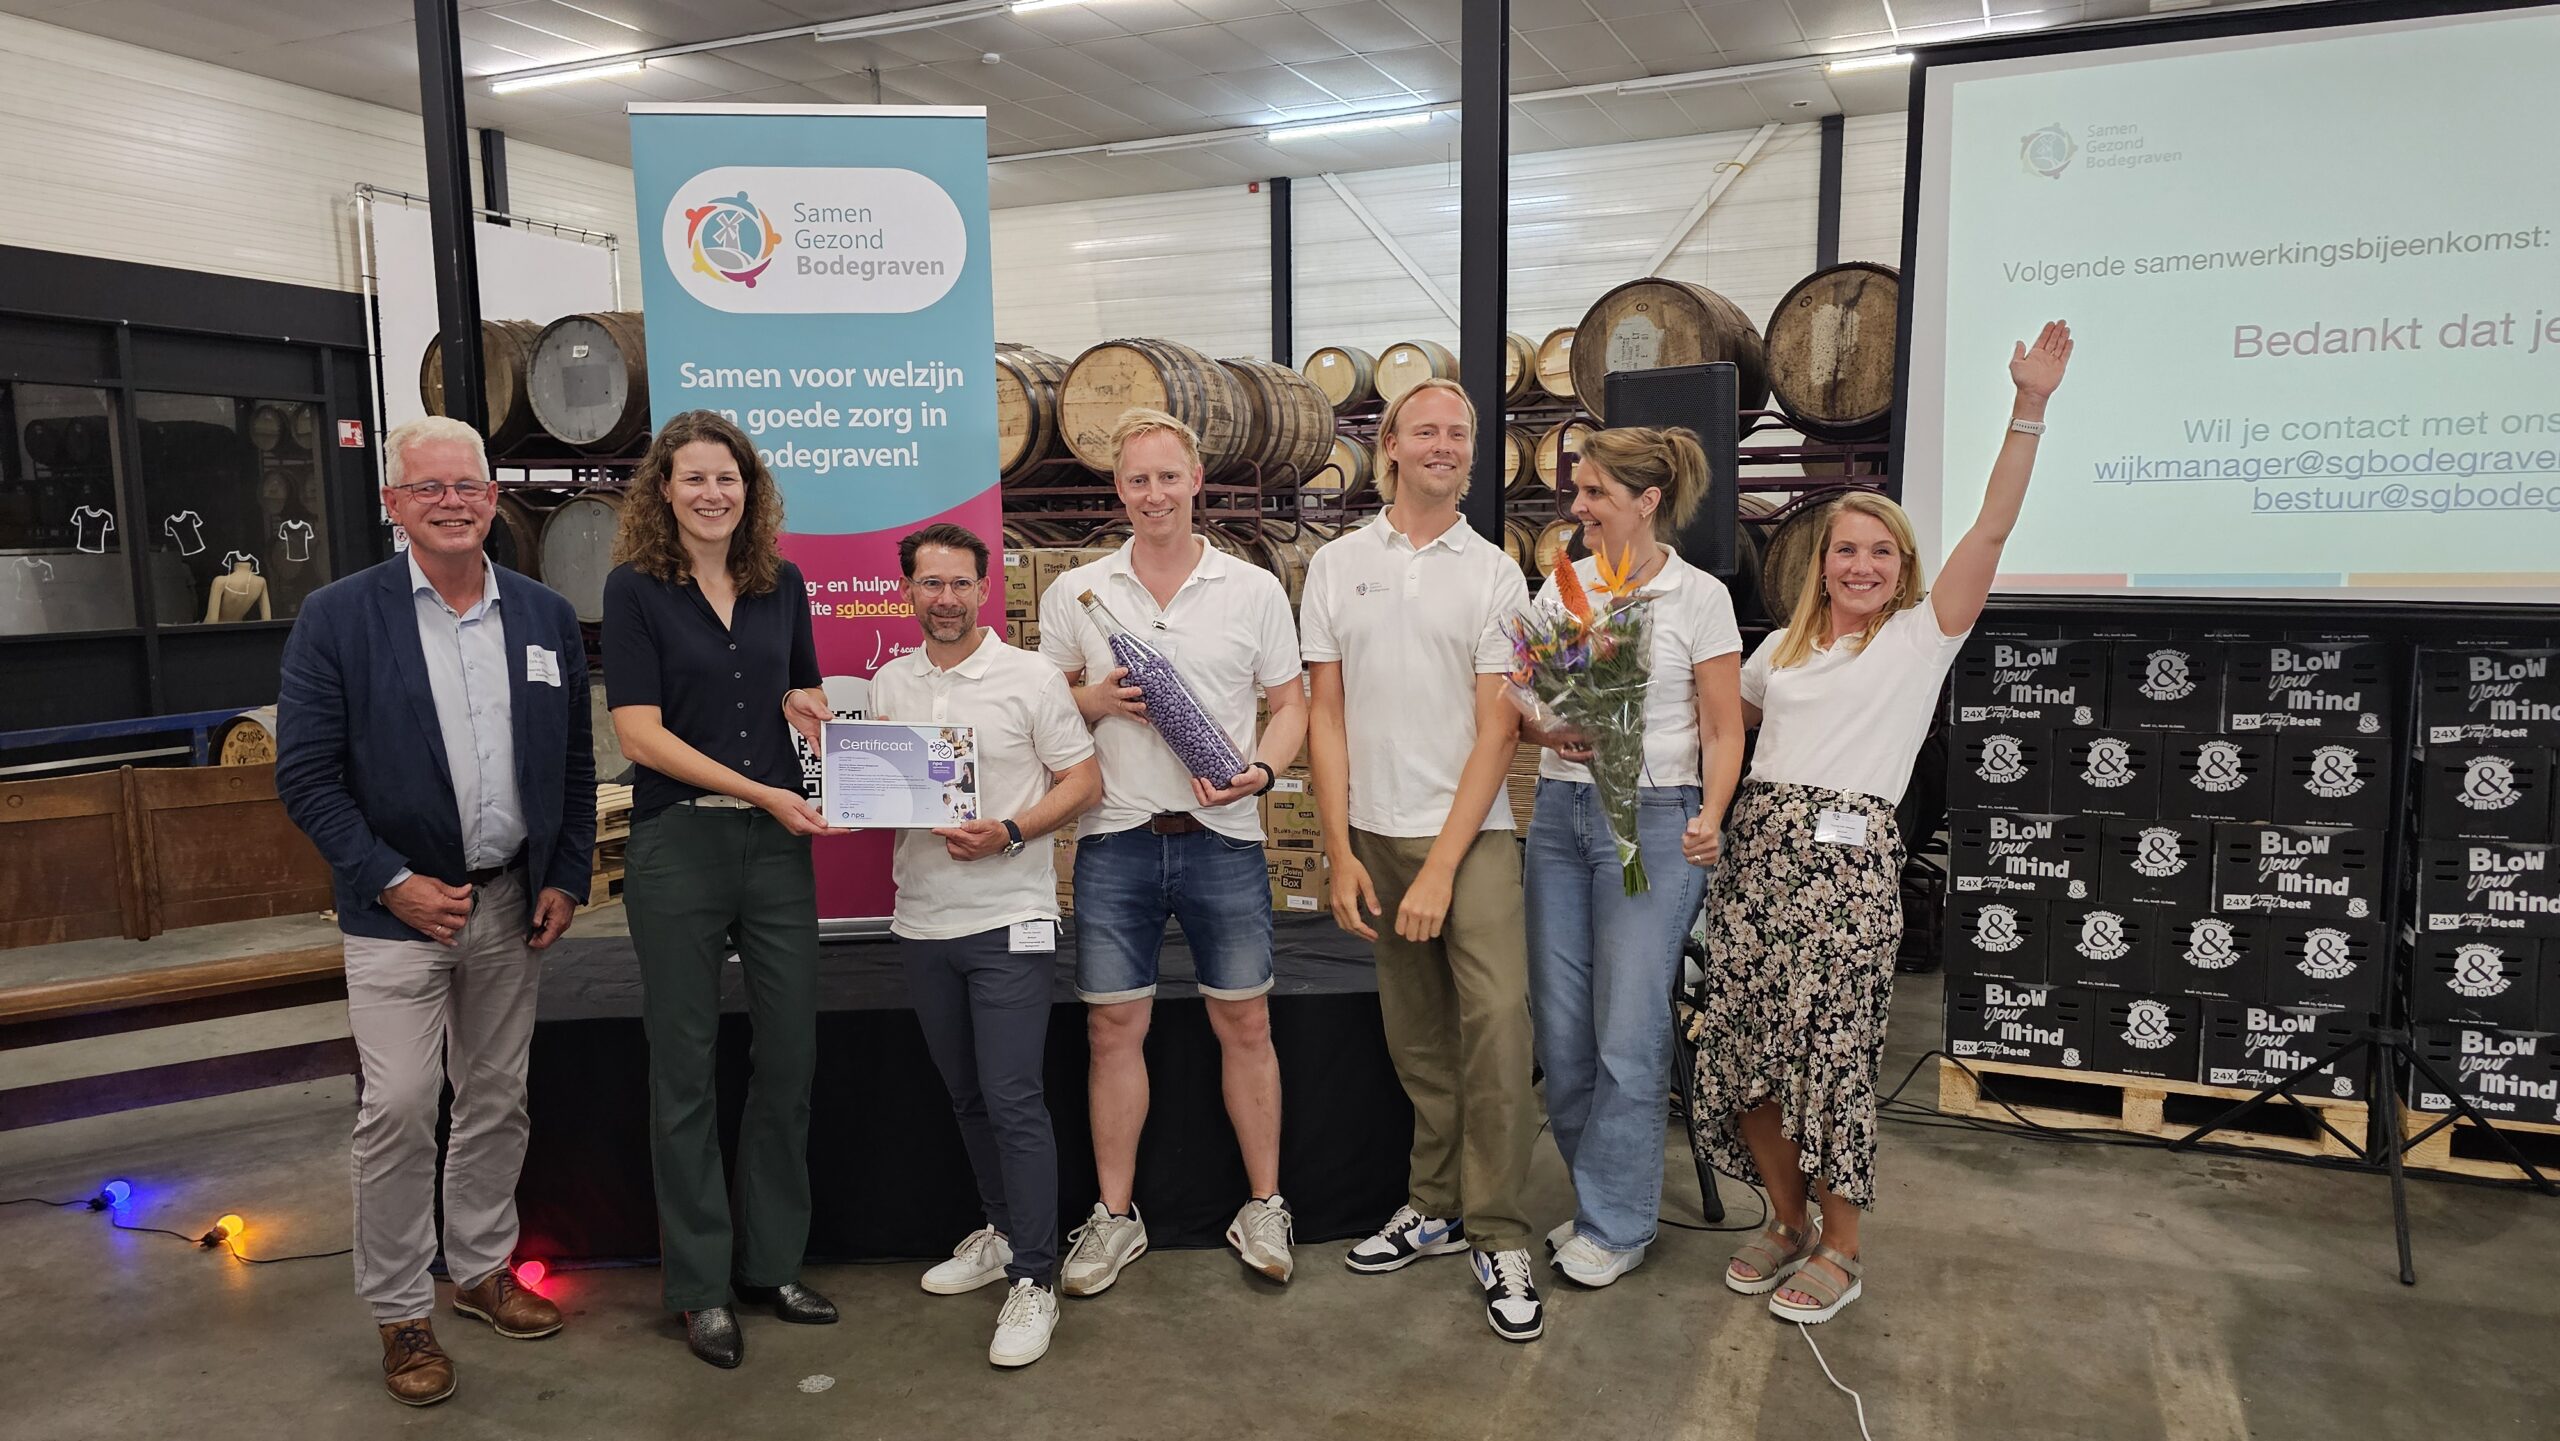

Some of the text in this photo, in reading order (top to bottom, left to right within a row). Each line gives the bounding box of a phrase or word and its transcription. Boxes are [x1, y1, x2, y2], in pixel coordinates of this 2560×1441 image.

[2087, 124, 2138, 138] Samen
[2086, 136, 2144, 154] Gezond
[2086, 151, 2183, 169] Bodegraven
[793, 203, 872, 223] Samen
[795, 229, 884, 250] Gezond
[2003, 225, 2551, 286] Volgende samenwerkingsbijeenkomst:
[797, 255, 944, 280] Bodegraven
[2233, 309, 2560, 359] Bedankt dat je
[680, 360, 964, 393] Samen voor welzijn
[748, 401, 841, 436] goede
[849, 406, 912, 433] zorg
[921, 402, 947, 427] in
[2183, 411, 2560, 449] Wil je contact met ons
[759, 441, 919, 474] odegraven!
[2094, 448, 2560, 486] wijkmanager@sgbodegrave
[827, 580, 848, 592] en
[853, 576, 899, 595] hulpv
[810, 601, 832, 615] ite
[889, 643, 900, 656] of
[1992, 668, 2037, 695] your
[2268, 673, 2318, 701] your
[2468, 682, 2523, 712] your
[1963, 710, 1983, 718] 24X
[2235, 717, 2257, 727] 24X
[840, 739, 913, 751] Certificaat
[2433, 730, 2457, 739] 24X
[1988, 840, 2033, 866] your
[2258, 856, 2308, 883] your
[1959, 879, 1979, 888] 24X
[2466, 873, 2521, 901] your
[2225, 898, 2247, 906] 24X
[2432, 917, 2455, 926] 24X
[1984, 1007, 2027, 1031] your
[1955, 1042, 1974, 1051] 24X
[2244, 1032, 2294, 1059] your
[2212, 1071, 2234, 1081] 24X
[2459, 1056, 2512, 1083] your
[2423, 1097, 2447, 1105] 24X
